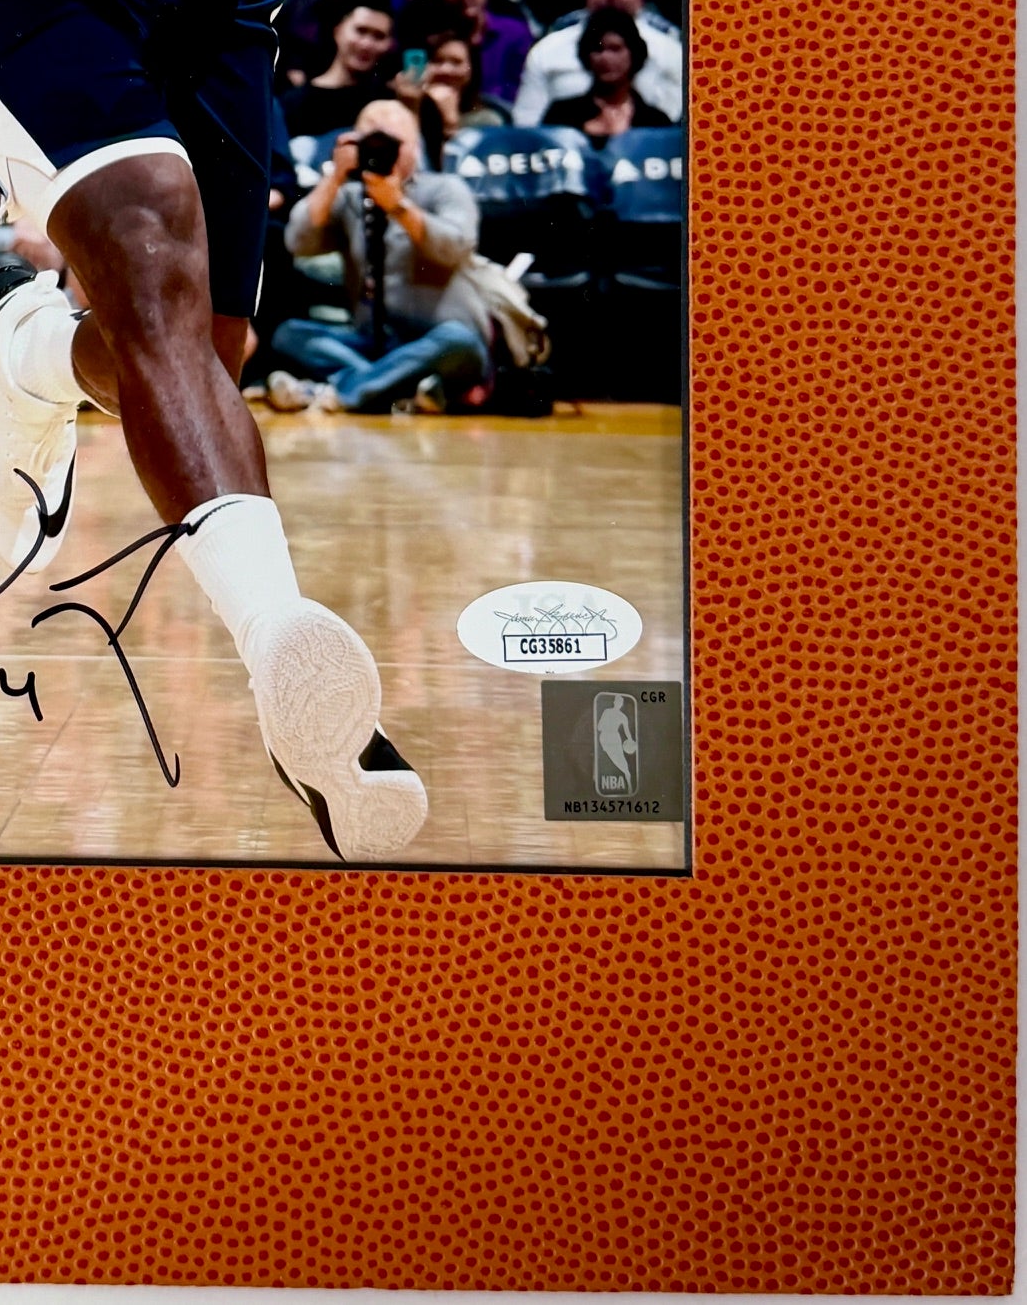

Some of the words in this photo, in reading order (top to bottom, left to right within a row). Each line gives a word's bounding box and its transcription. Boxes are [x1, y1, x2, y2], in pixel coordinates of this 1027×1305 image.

[487, 148, 584, 174] DELTA
[519, 638, 582, 655] CG35861
[640, 691, 667, 703] CGR
[601, 775, 626, 790] NBA
[564, 800, 660, 813] NB134571612
